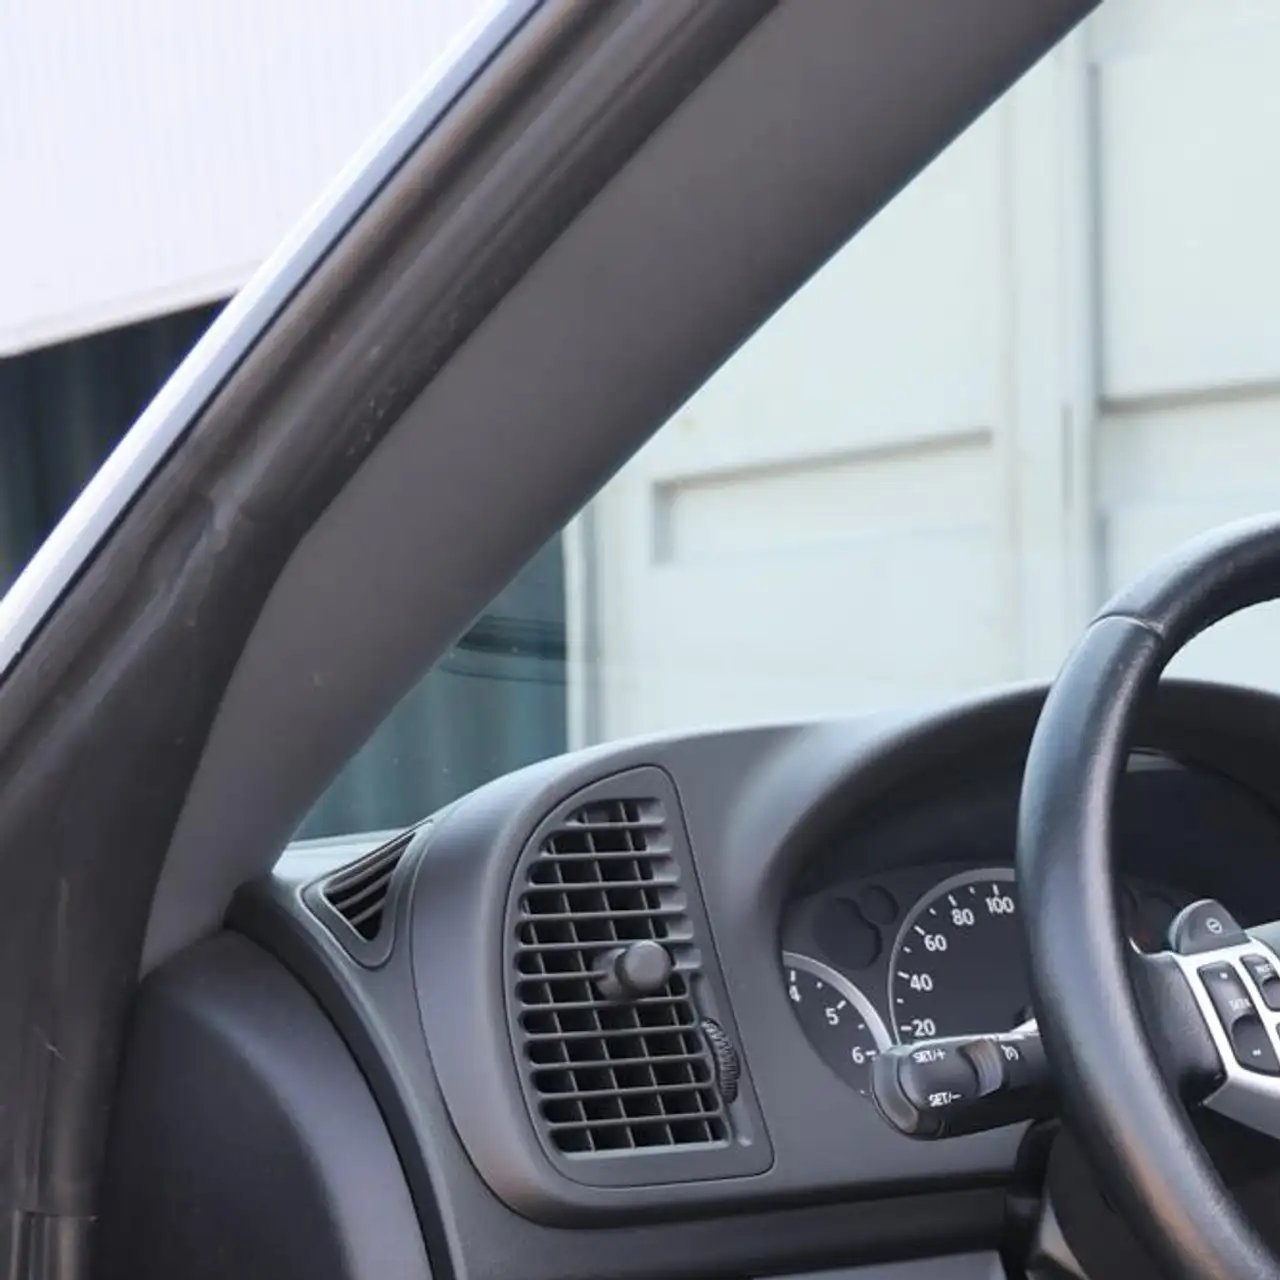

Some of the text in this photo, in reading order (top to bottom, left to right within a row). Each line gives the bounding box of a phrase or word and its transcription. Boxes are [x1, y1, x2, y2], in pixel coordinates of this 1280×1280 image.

[985, 897, 1015, 914] 100
[952, 908, 974, 926] 80
[924, 934, 947, 951] 60
[910, 974, 933, 992] 40
[825, 1008, 839, 1025] 5
[912, 1019, 936, 1037] 20
[852, 1046, 865, 1063] 6
